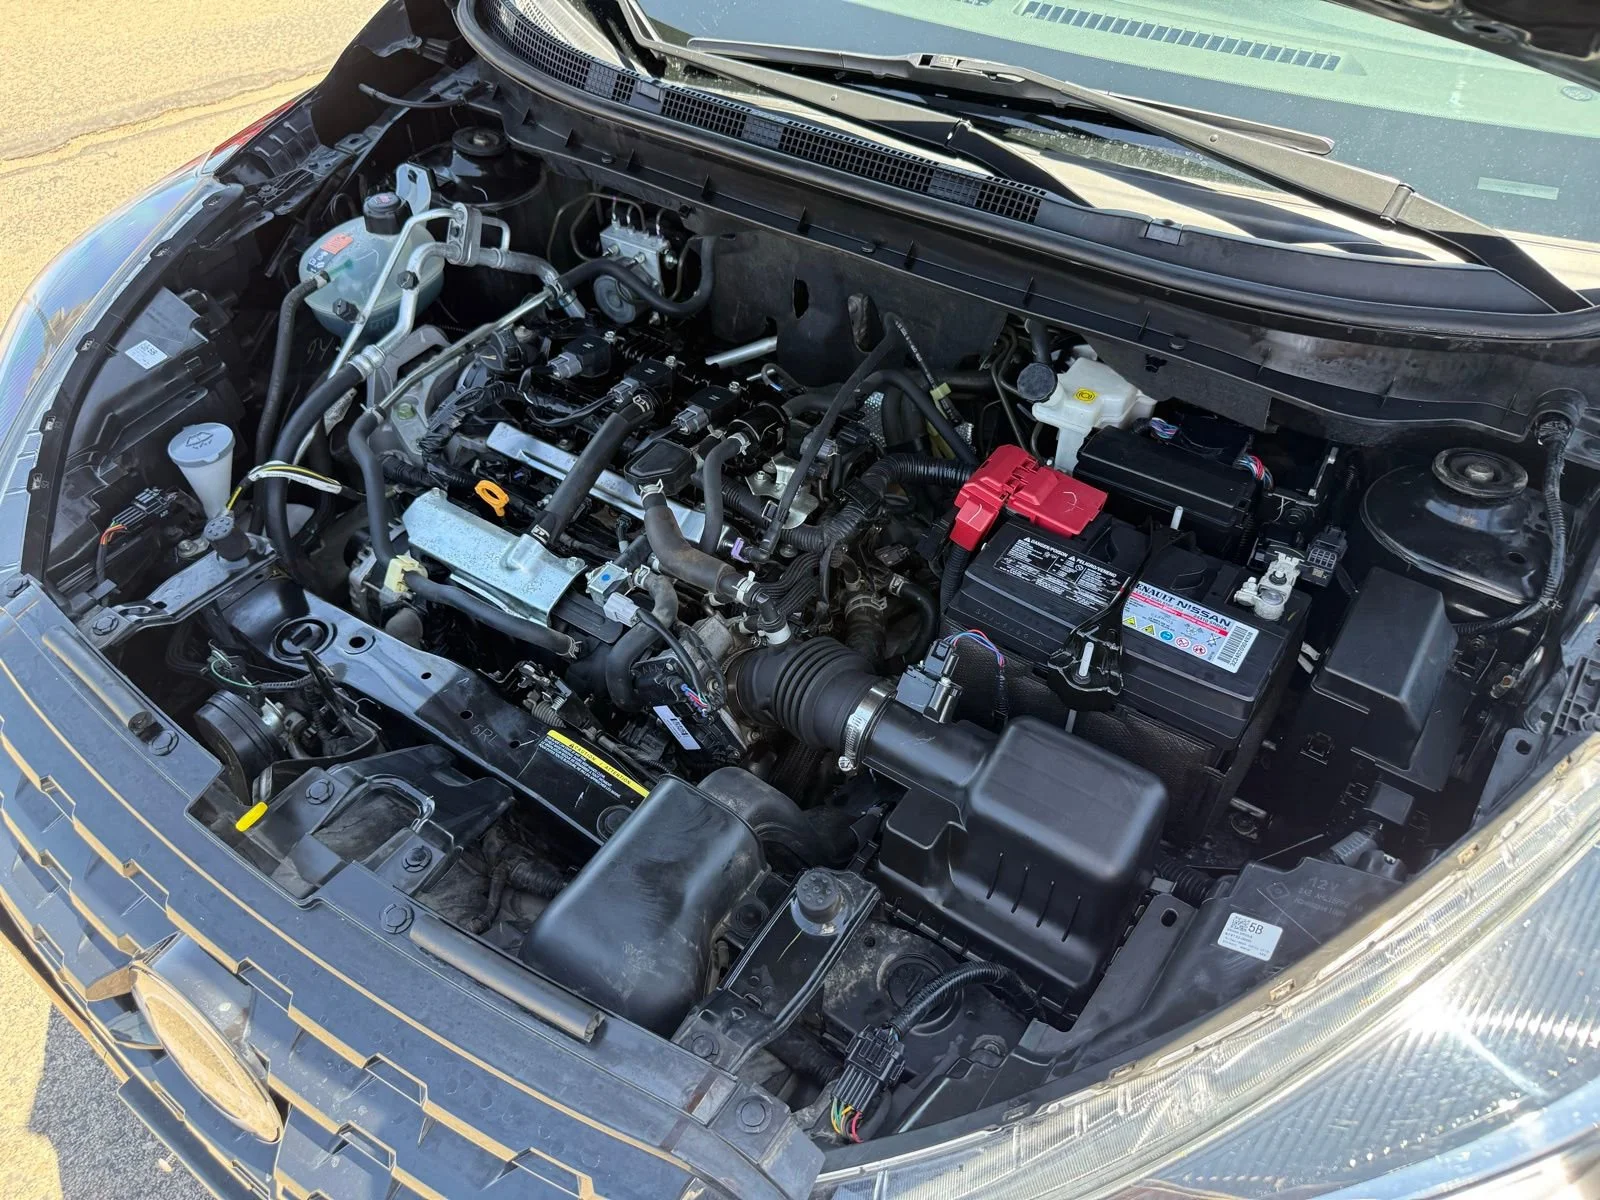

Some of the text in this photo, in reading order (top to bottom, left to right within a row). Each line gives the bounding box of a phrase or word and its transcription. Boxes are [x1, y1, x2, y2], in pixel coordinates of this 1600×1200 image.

[1135, 583, 1175, 603] ENAULT
[1176, 600, 1231, 627] NISSAN
[573, 743, 596, 762] CAUTION
[605, 765, 632, 785] ATTENTION
[1248, 922, 1264, 935] 5B
